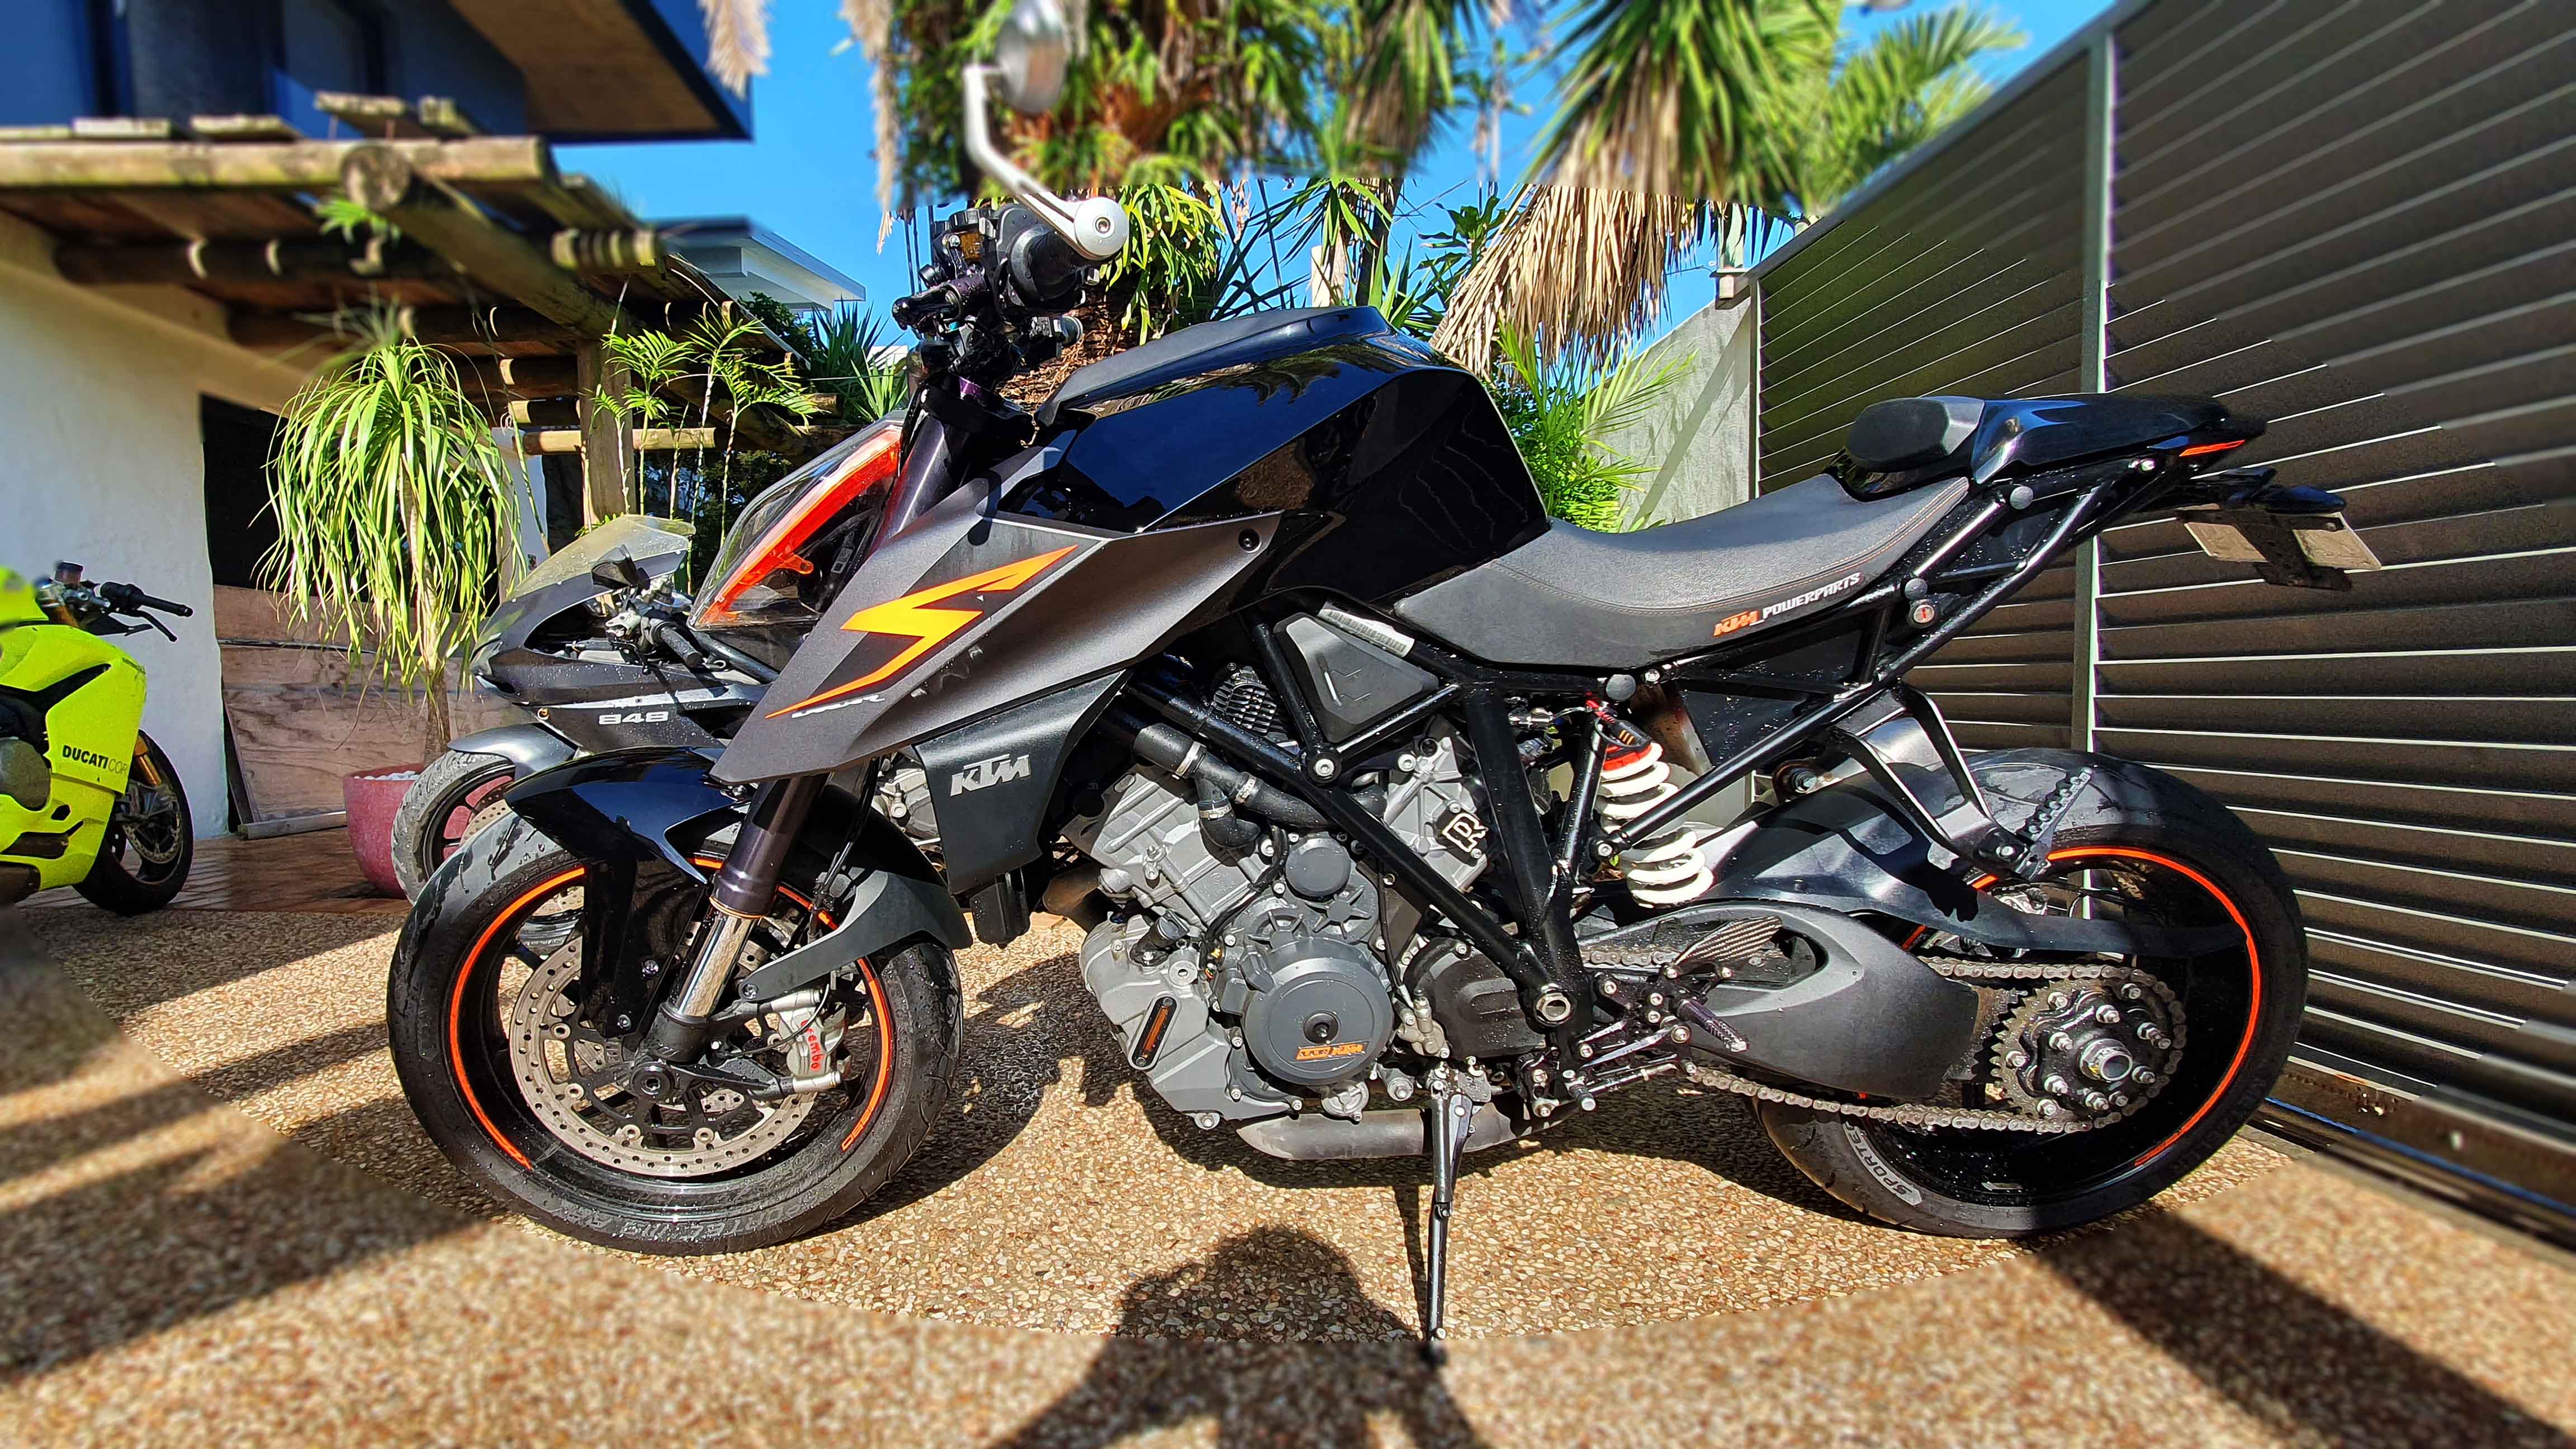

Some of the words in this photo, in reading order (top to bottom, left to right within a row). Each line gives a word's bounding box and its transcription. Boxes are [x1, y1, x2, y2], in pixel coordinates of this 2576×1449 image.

[1713, 611, 1759, 636] KTM
[1763, 572, 1862, 619] POWERPARTS
[599, 711, 669, 725] 848
[950, 754, 1031, 797] KTM
